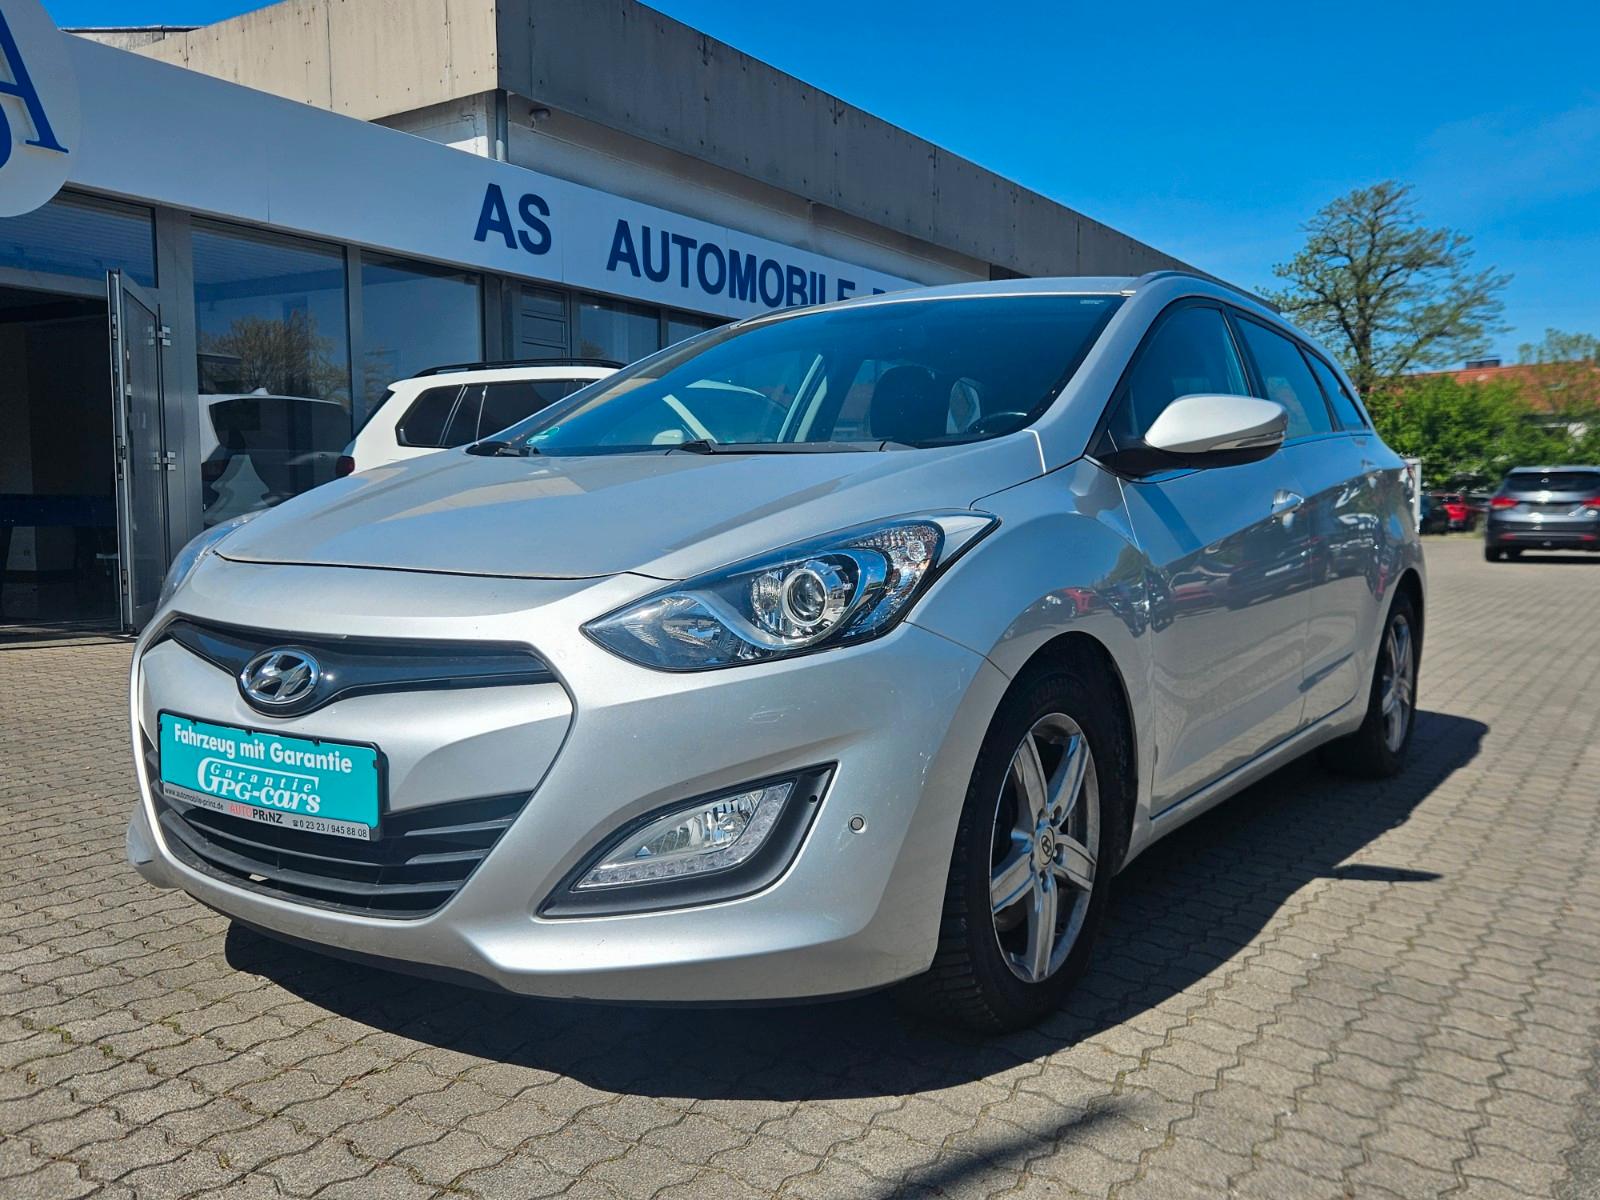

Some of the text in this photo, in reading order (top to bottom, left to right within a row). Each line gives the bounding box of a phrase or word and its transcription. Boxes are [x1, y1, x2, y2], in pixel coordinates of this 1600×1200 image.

[473, 182, 552, 256] AS
[174, 723, 353, 774] Fahrzeug mit Garantie
[210, 763, 312, 793] Garantie
[306, 821, 315, 830] 23
[316, 822, 326, 832] 23
[331, 824, 345, 834] 945
[346, 826, 356, 836] 88
[357, 828, 368, 838] 08
